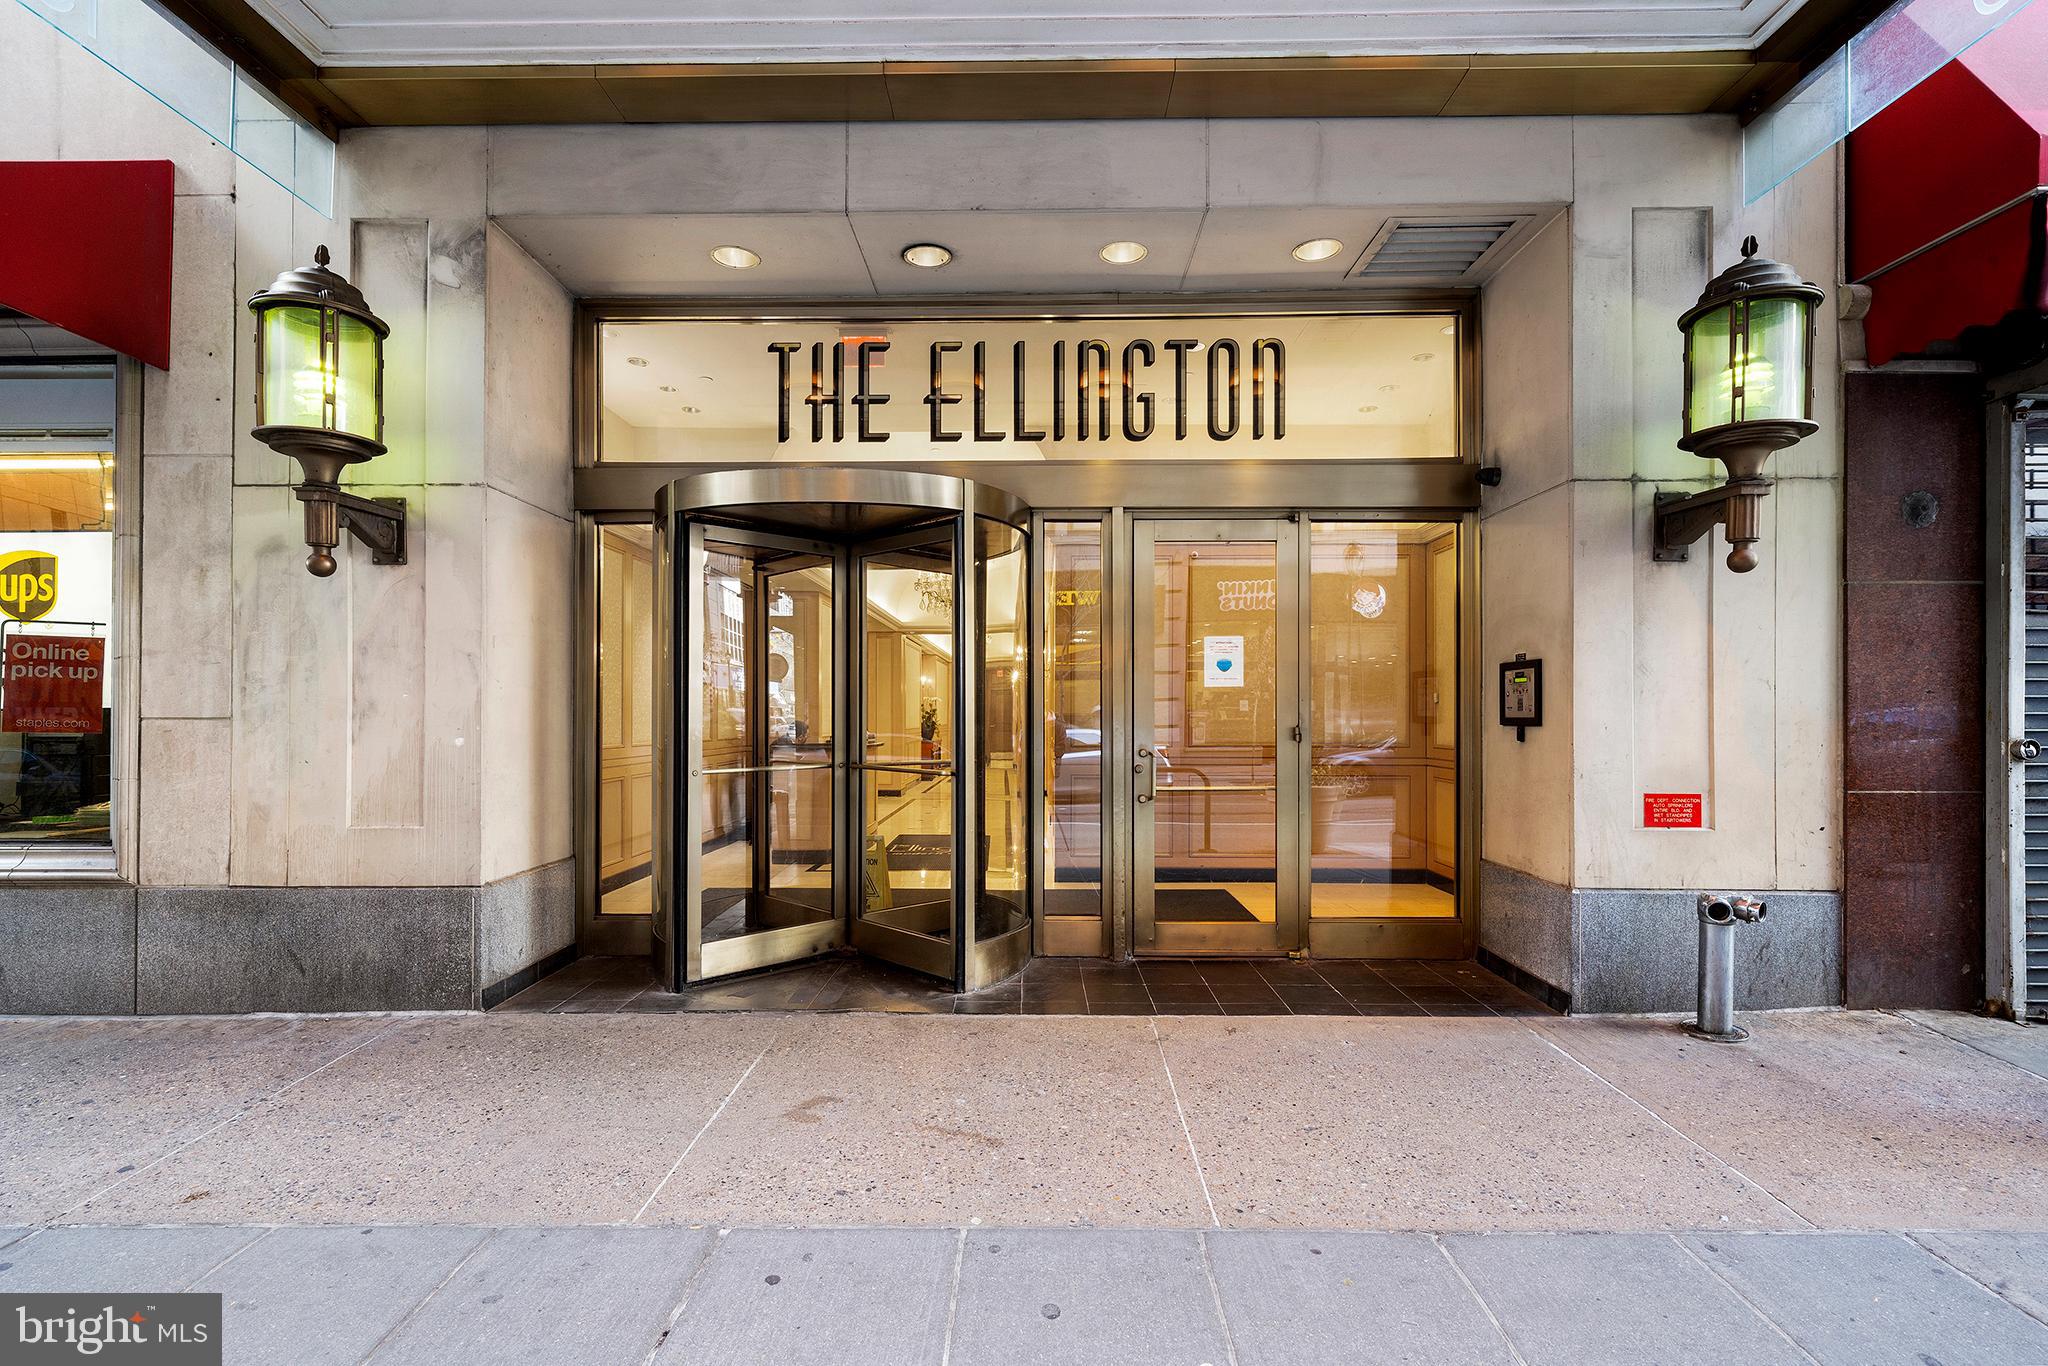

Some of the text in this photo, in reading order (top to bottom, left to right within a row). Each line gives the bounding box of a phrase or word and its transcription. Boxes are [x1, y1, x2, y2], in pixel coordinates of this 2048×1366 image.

[768, 338, 1287, 443] THE ELLINGTON
[1, 573, 54, 613] ups
[12, 642, 90, 661] Online
[11, 662, 98, 683] pick up
[15, 718, 90, 729] staples.com
